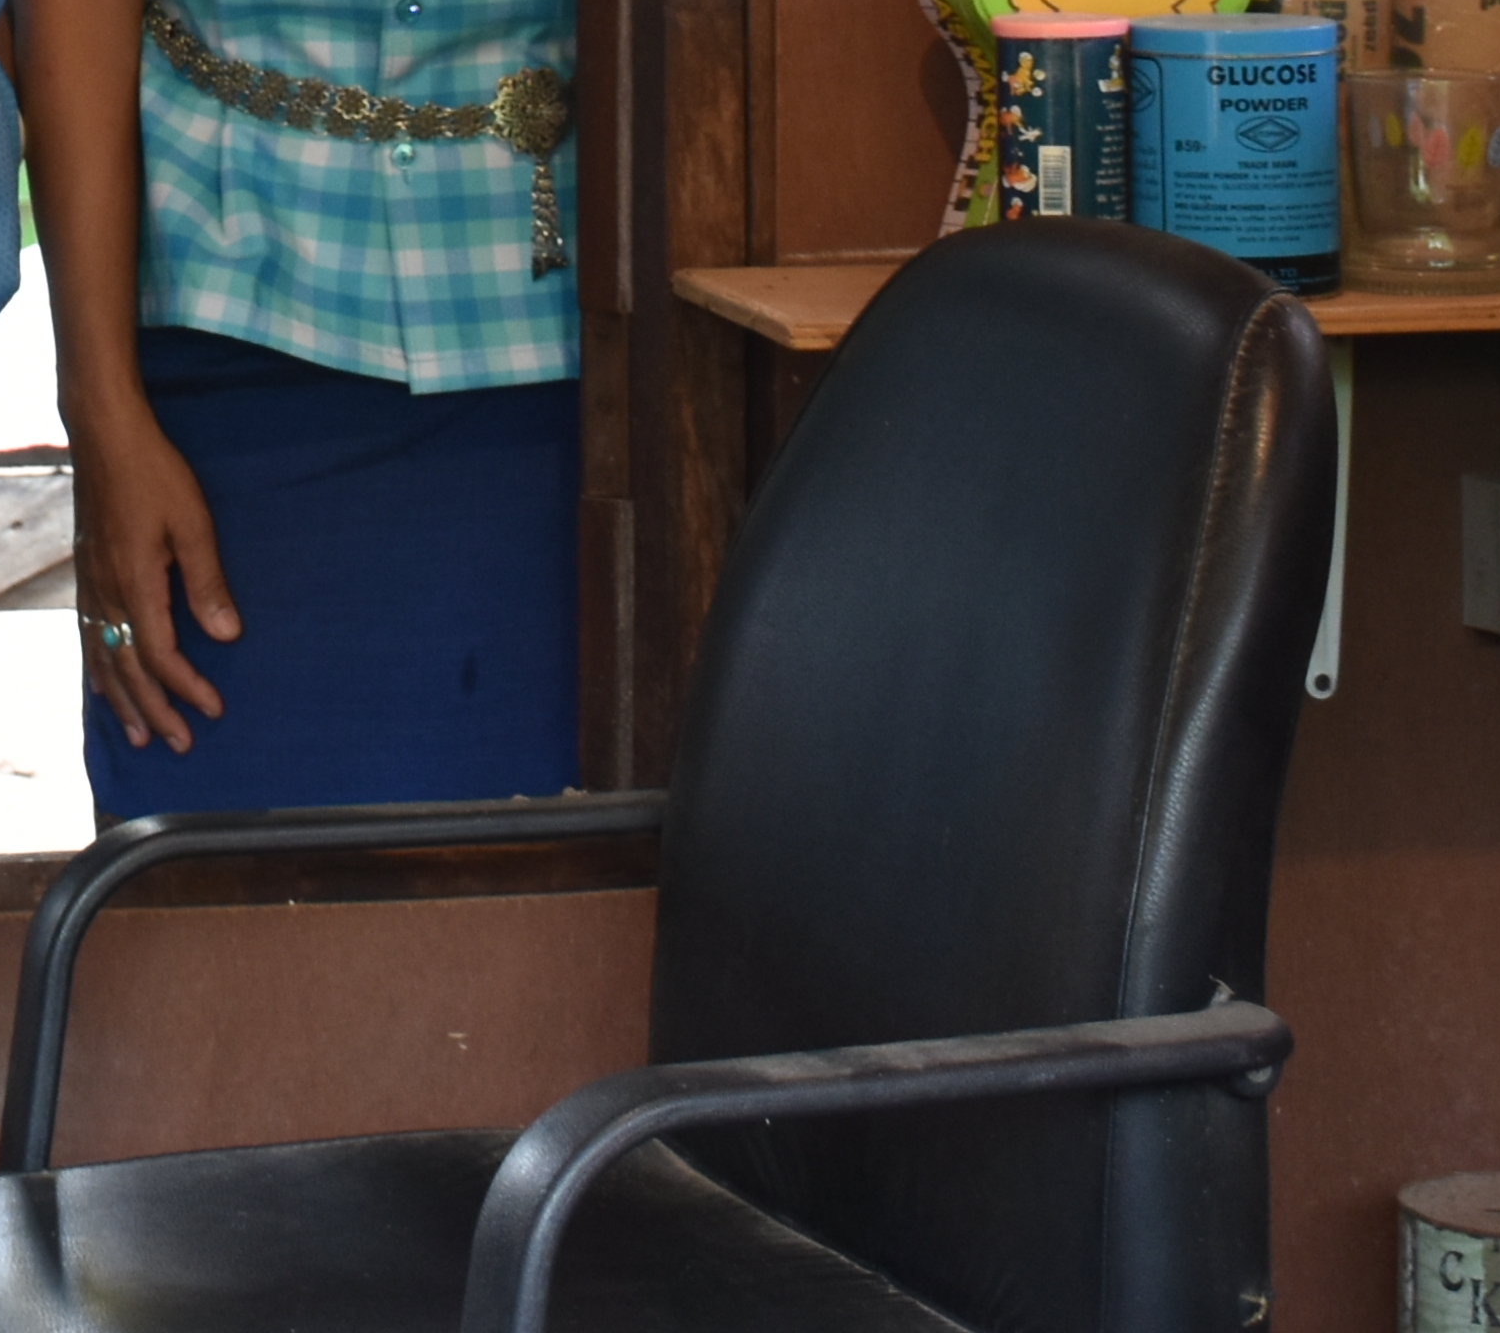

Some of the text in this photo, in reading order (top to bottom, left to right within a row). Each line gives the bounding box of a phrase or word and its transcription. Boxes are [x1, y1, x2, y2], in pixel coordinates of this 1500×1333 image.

[1206, 63, 1318, 86] GLUCOSE
[966, 46, 997, 163] MARCH
[1219, 96, 1309, 113] POWDER
